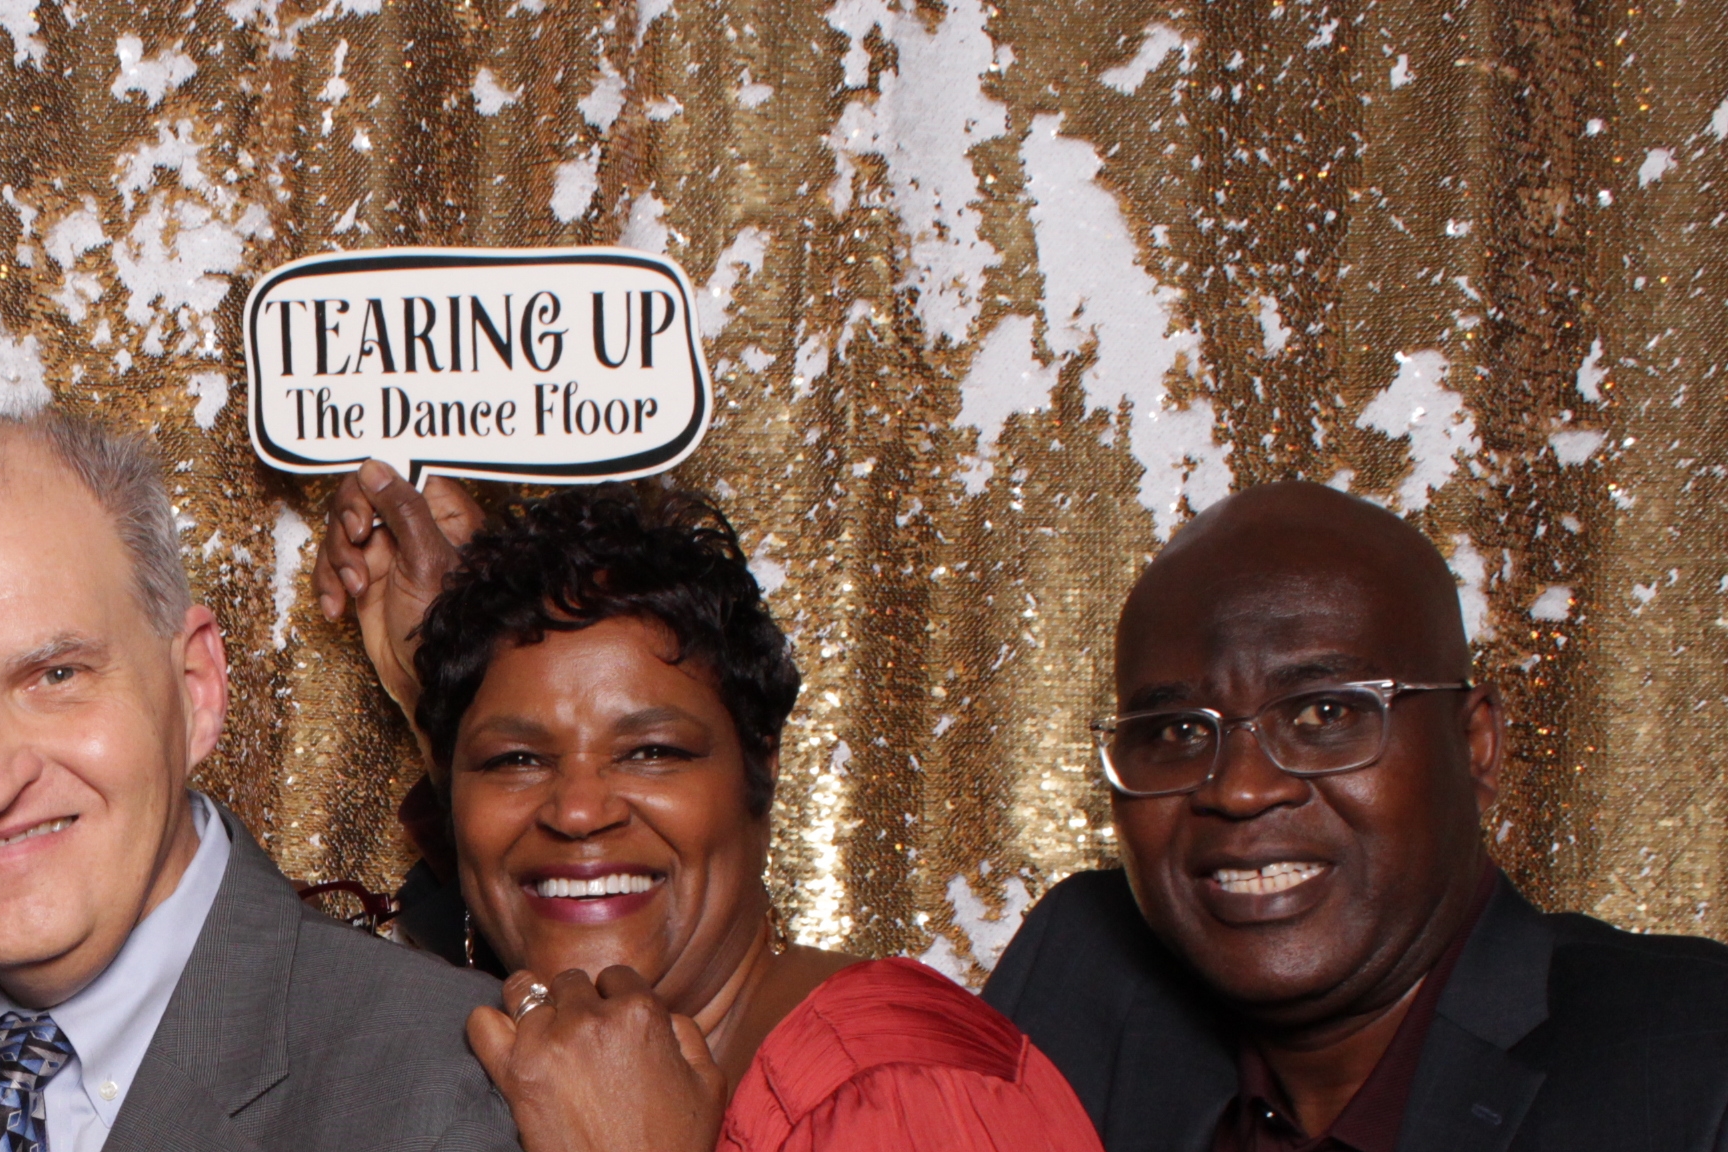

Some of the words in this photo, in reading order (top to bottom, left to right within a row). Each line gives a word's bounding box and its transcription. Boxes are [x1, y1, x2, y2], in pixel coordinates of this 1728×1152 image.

[265, 291, 569, 376] TEARING
[590, 290, 675, 368] UP
[286, 387, 364, 440] The
[381, 386, 517, 439] Dance
[533, 380, 658, 436] Floor
